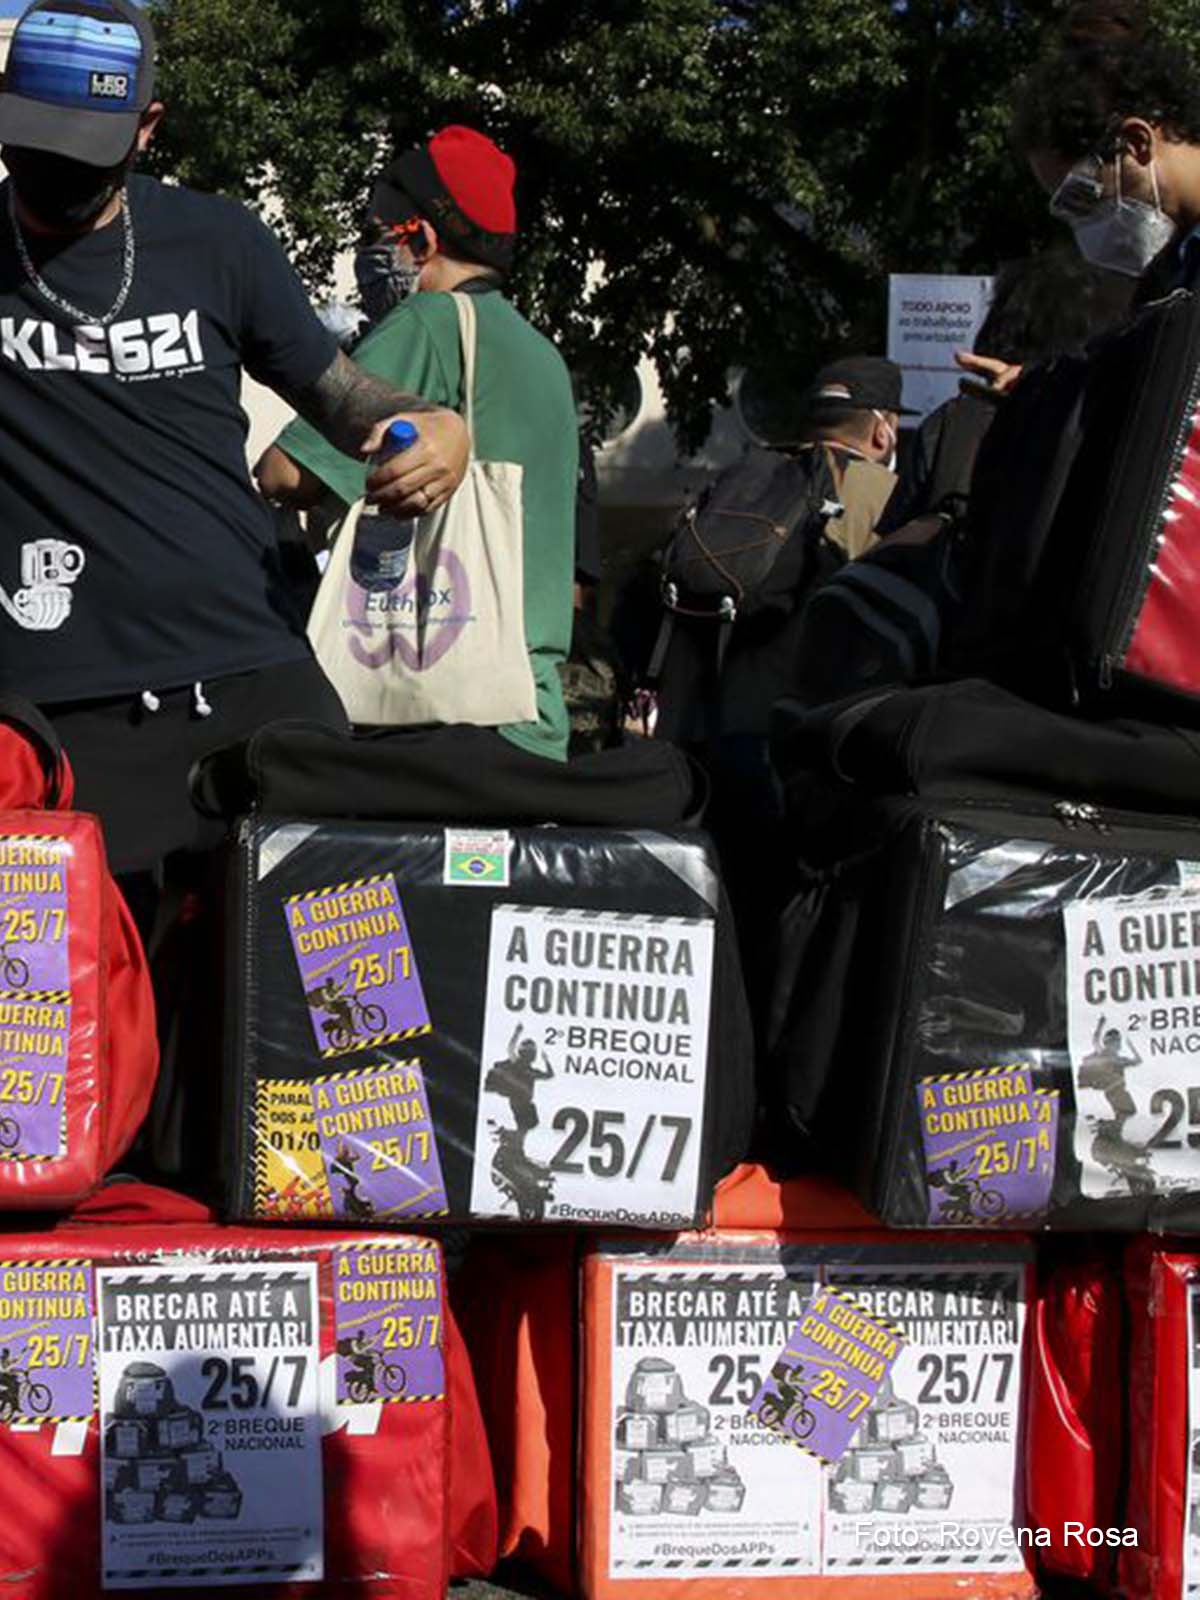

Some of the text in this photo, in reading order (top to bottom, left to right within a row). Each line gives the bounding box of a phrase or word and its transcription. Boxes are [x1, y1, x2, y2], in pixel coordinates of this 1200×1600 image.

[290, 884, 395, 929] A GUERRA
[4, 910, 66, 943] 25/7
[298, 916, 402, 954] CONTINUA
[1083, 920, 1104, 957] A
[506, 926, 694, 977] A GUERRA
[351, 948, 412, 994] 25/7
[504, 975, 691, 1025] CONTINUA
[568, 1026, 692, 1057] BREQUE
[565, 1054, 695, 1083] NACIONAL
[0, 1070, 63, 1105] 25/7
[317, 1070, 420, 1110] A GUERRA
[923, 1076, 1028, 1109] A GUERRA
[322, 1099, 426, 1137] CONTINUA
[926, 1103, 1031, 1135] CONTINUA
[371, 1131, 431, 1173] 25/7
[549, 1106, 693, 1183] 25/7
[975, 1138, 1039, 1178] 25/7
[4, 1271, 86, 1293] GUERRA
[338, 1253, 438, 1276] A GUERRA
[116, 1284, 298, 1321] BRECAR ATÉ A
[339, 1279, 437, 1301] CONTINUA
[630, 1282, 801, 1316] BRECAR ATÉ A
[108, 1320, 308, 1352] TAXA AUMENTAR!
[383, 1315, 440, 1349] 25/7
[620, 1321, 676, 1347] TAXA
[812, 1295, 827, 1314] A
[827, 1303, 898, 1361] GUERRA
[27, 1335, 89, 1368] 25/7
[799, 1316, 890, 1381] CONTINUA
[201, 1355, 307, 1409] 25/7
[810, 1369, 872, 1422] 25/7
[917, 1354, 1013, 1405] 25/7
[225, 1417, 305, 1434] BREQUE
[938, 1430, 1010, 1443] NACIONAL
[939, 1412, 1010, 1428] BREQUE
[225, 1436, 304, 1451] NACIONAL
